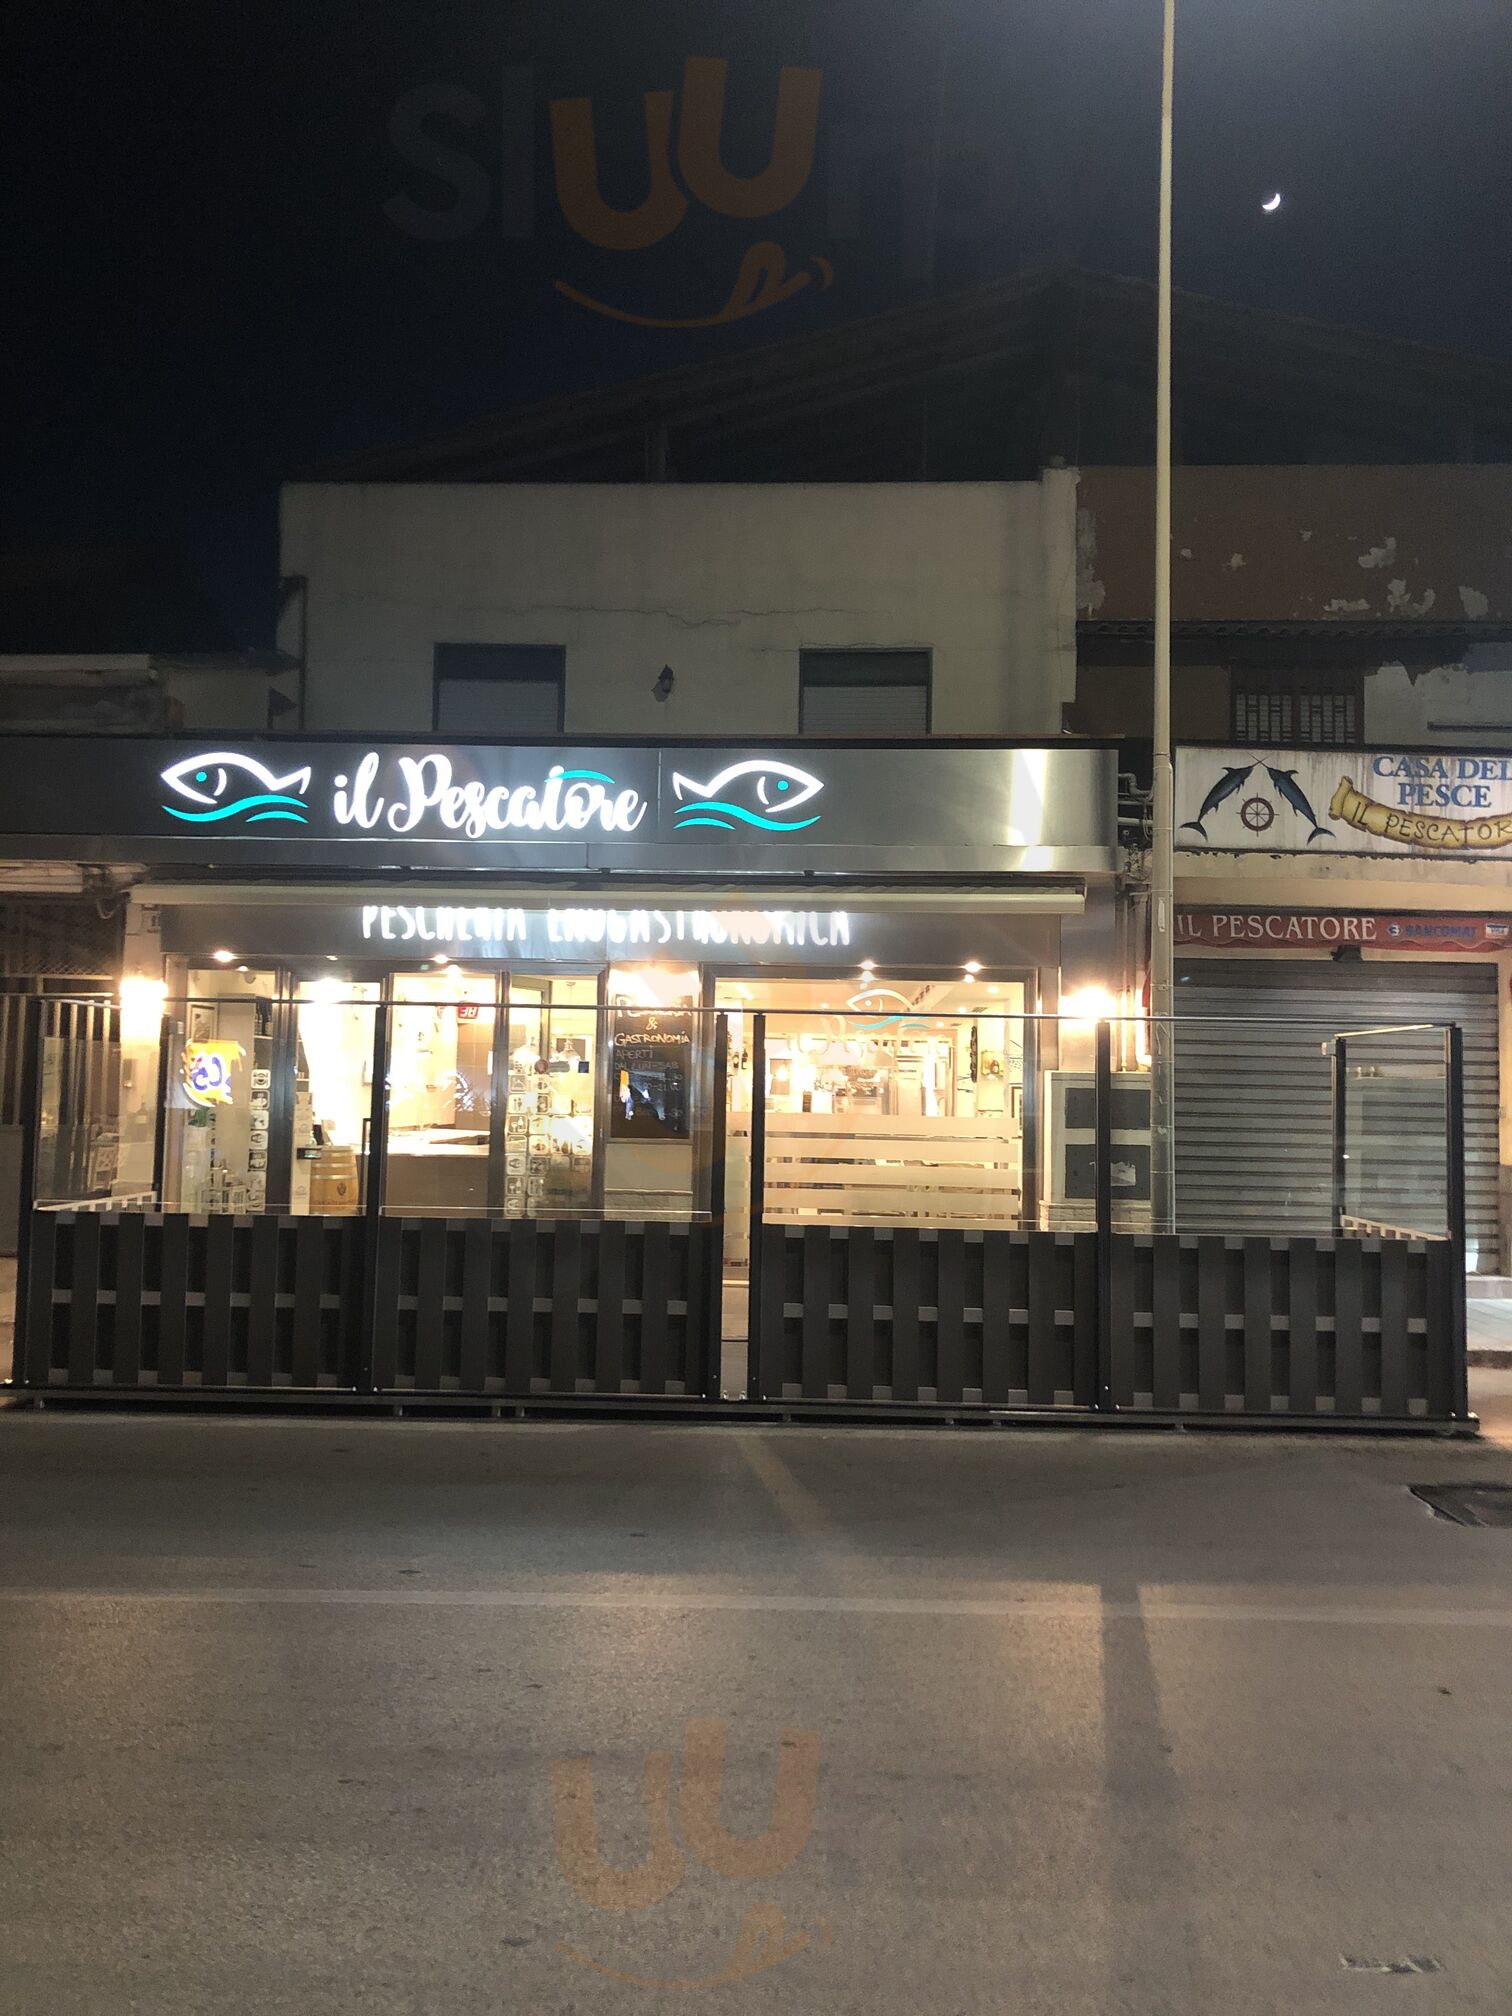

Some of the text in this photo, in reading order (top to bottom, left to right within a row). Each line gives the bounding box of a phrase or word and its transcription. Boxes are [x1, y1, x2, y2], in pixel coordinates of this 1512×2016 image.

[1373, 756, 1512, 780] CASA DEL
[333, 752, 647, 838] il Pescatore
[1397, 783, 1491, 807] PESCE
[1352, 801, 1369, 826] IL
[1177, 914, 1377, 940] IL PESCATORE
[645, 1016, 658, 1030] &
